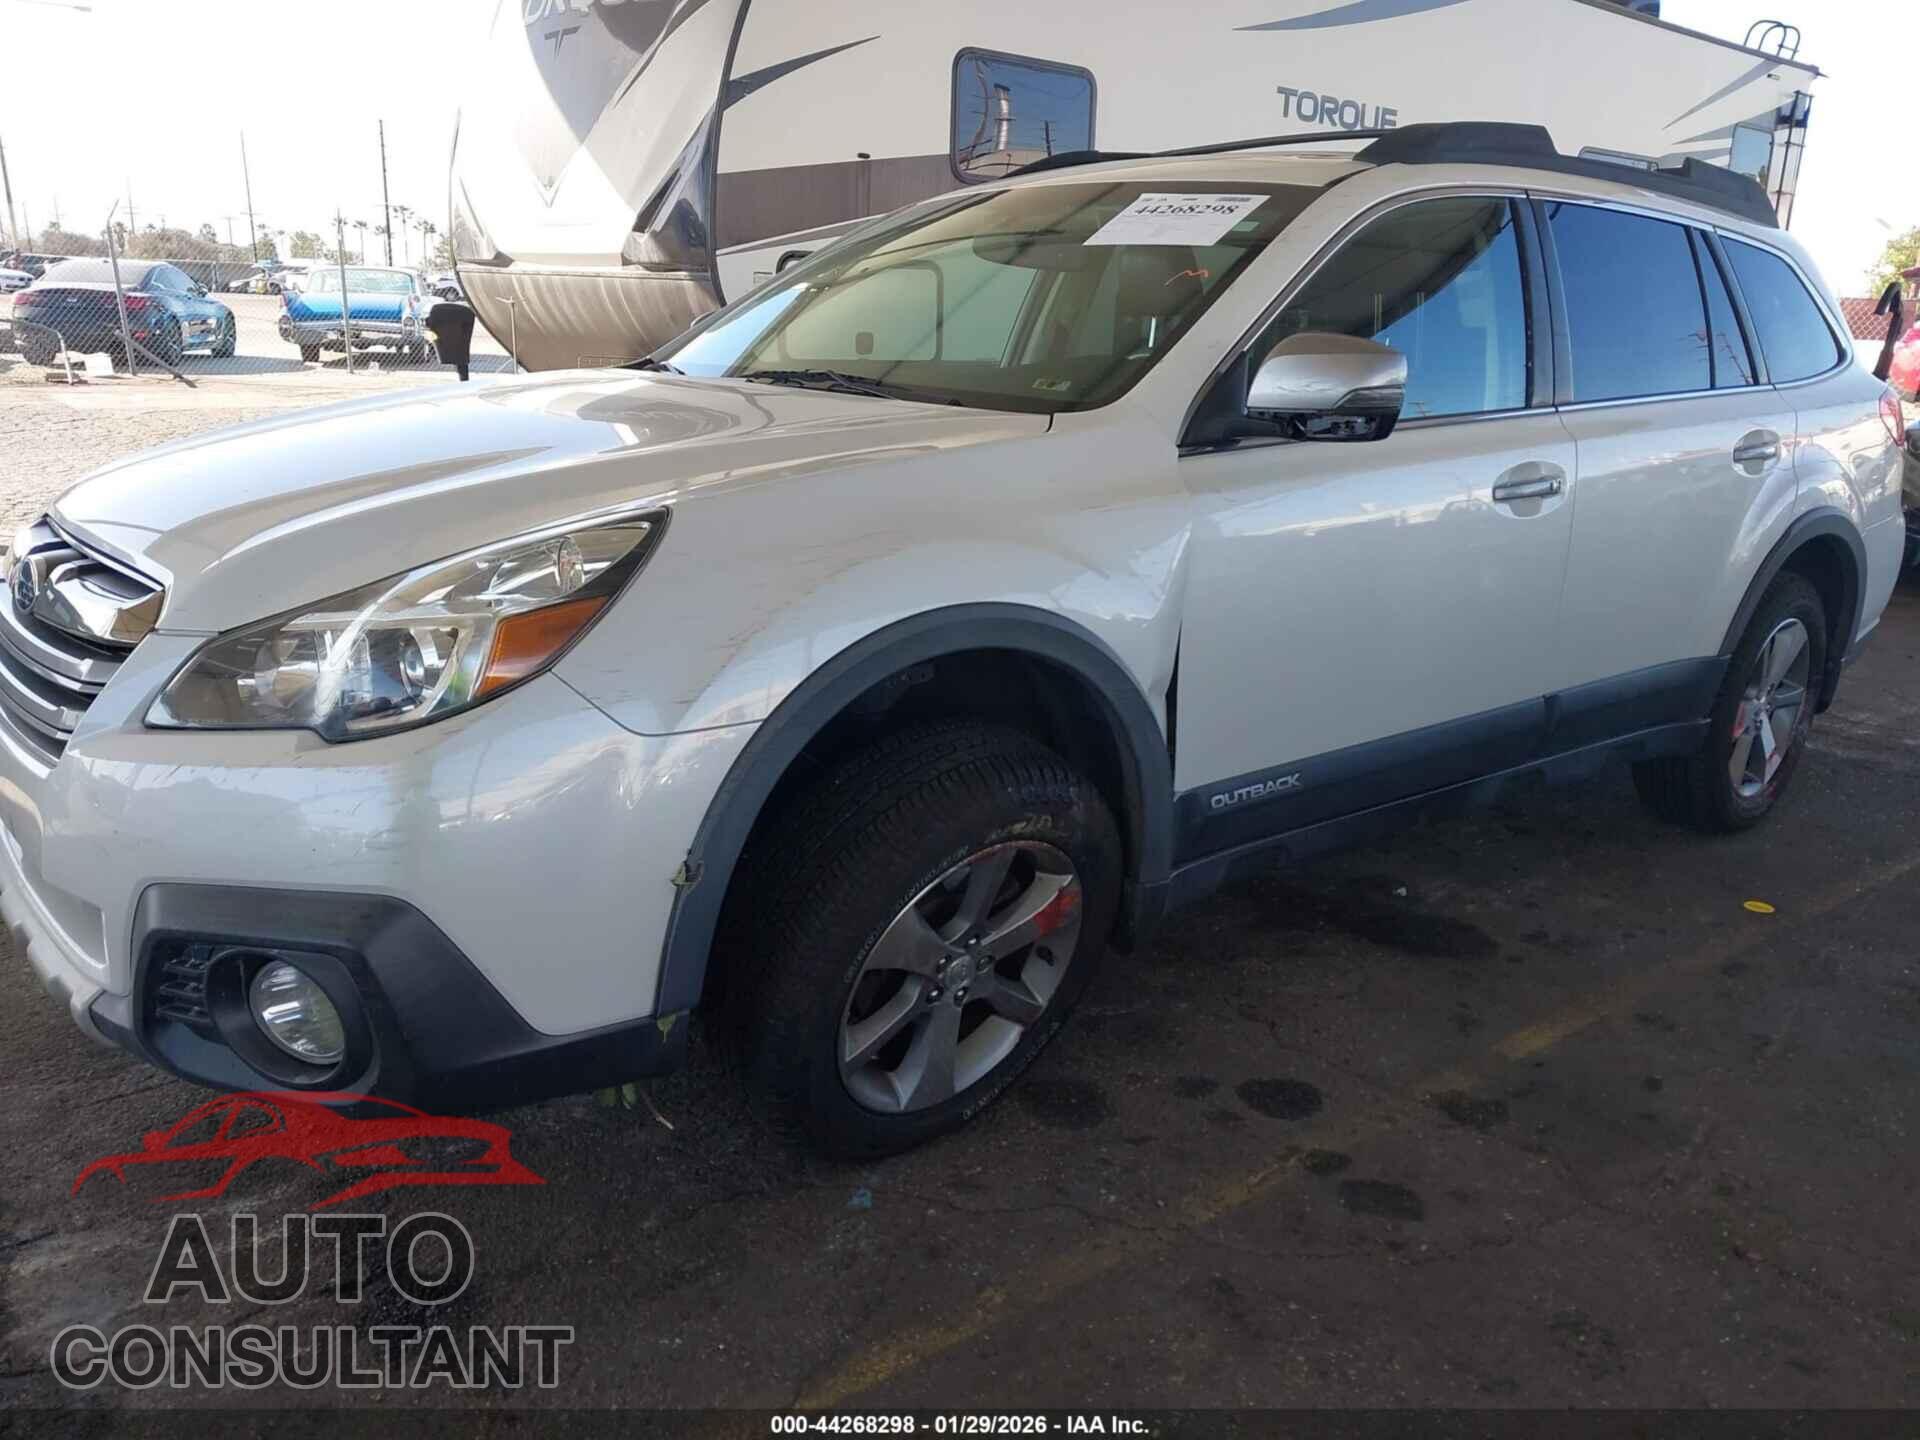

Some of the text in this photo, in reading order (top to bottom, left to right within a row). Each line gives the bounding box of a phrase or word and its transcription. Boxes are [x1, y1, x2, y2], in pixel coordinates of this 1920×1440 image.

[1277, 86, 1398, 130] TORQUE
[1134, 204, 1240, 216] 44268298
[1210, 773, 1301, 809] OUTBACK
